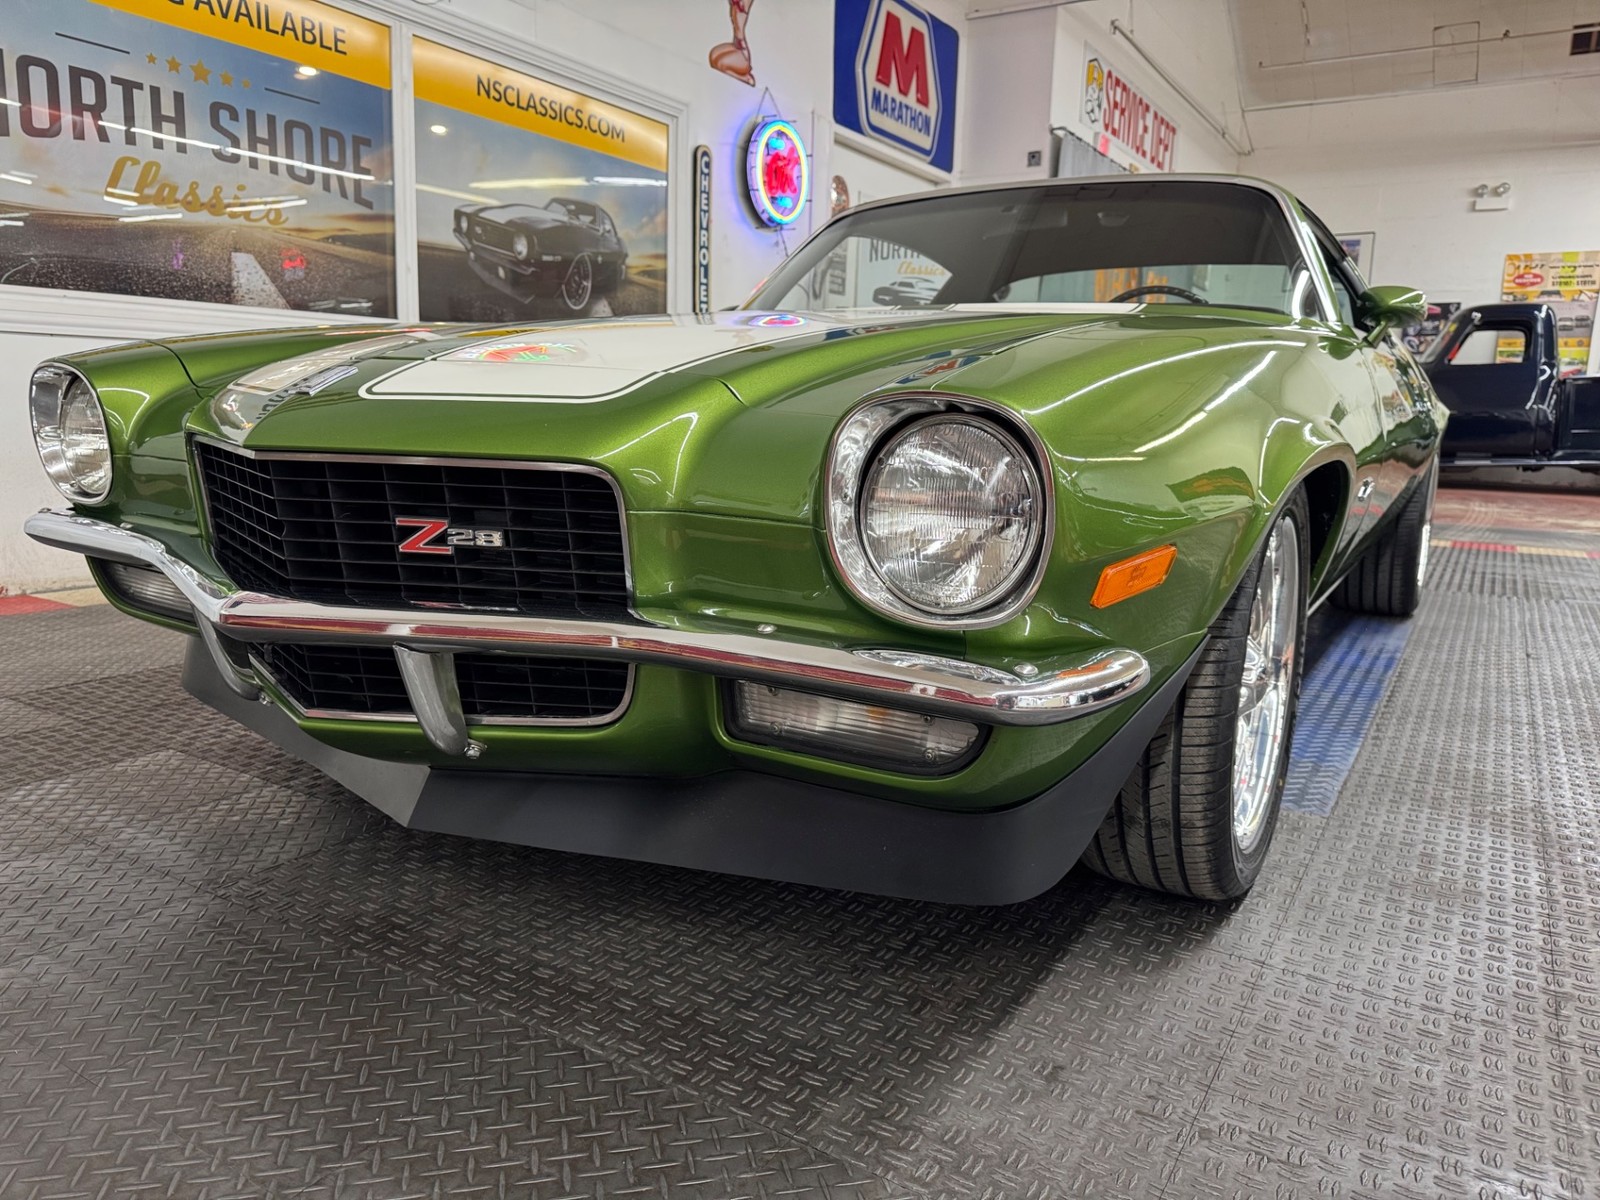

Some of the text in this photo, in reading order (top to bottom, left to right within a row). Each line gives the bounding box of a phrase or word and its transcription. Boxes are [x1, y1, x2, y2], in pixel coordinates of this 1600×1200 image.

[875, 10, 930, 109] M
[0, 48, 374, 210] ORTH SHORE
[476, 74, 626, 143] NSCLASSICS.COM
[871, 87, 932, 137] MARATHON
[1103, 69, 1150, 160] SERVICE
[104, 155, 290, 226] Classics
[699, 156, 710, 314] CHEVROLET
